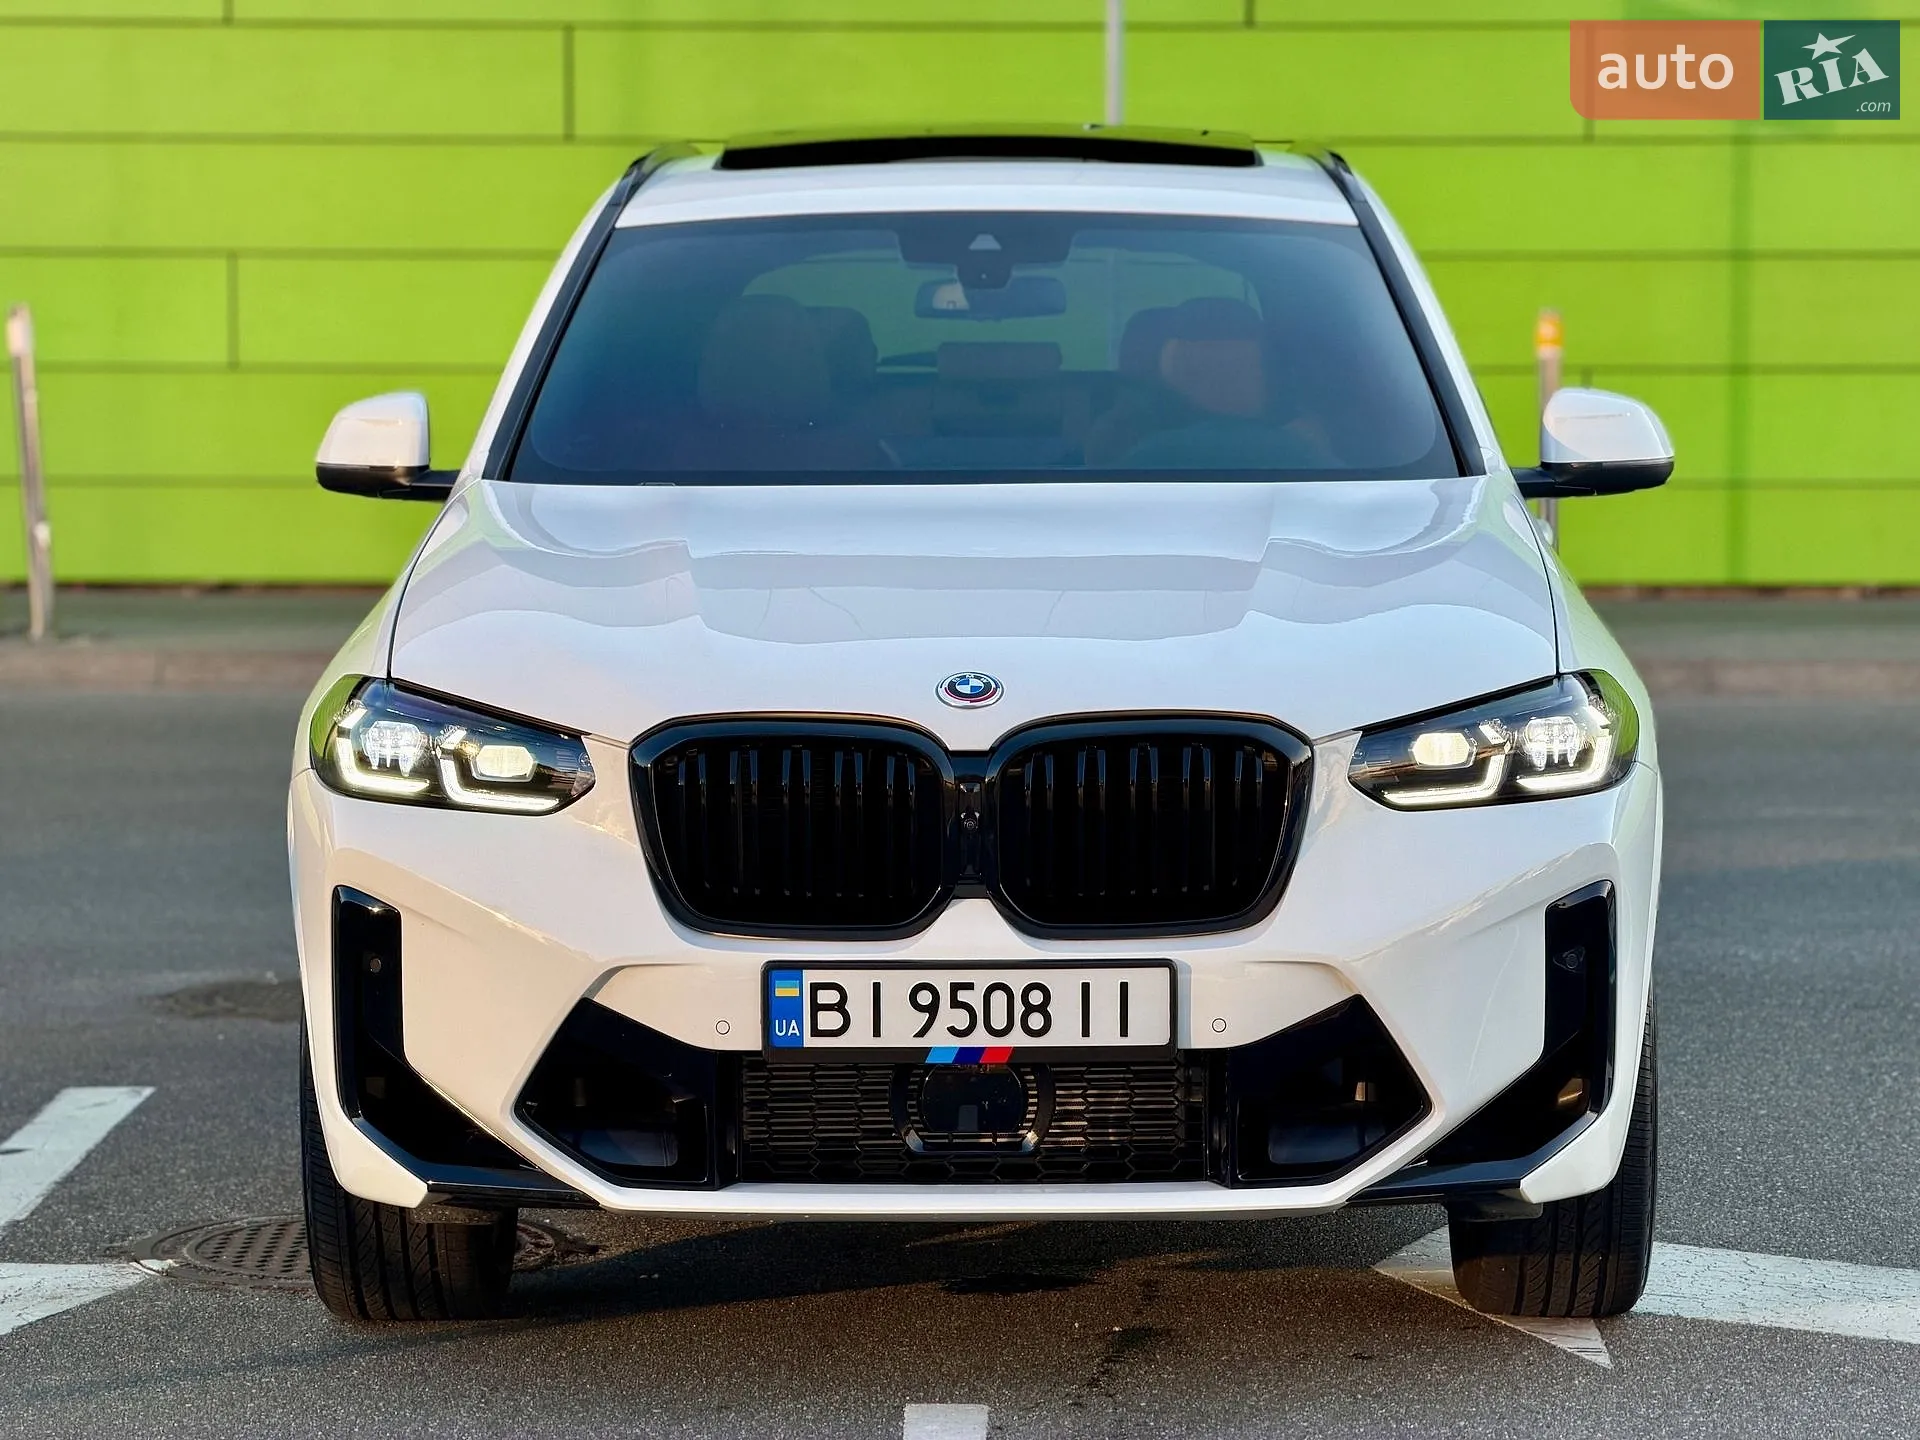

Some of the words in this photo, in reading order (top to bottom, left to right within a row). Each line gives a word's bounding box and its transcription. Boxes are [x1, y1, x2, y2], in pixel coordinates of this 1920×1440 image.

[775, 1019, 800, 1037] UA
[809, 981, 882, 1039] BI
[908, 981, 1053, 1039] 9508
